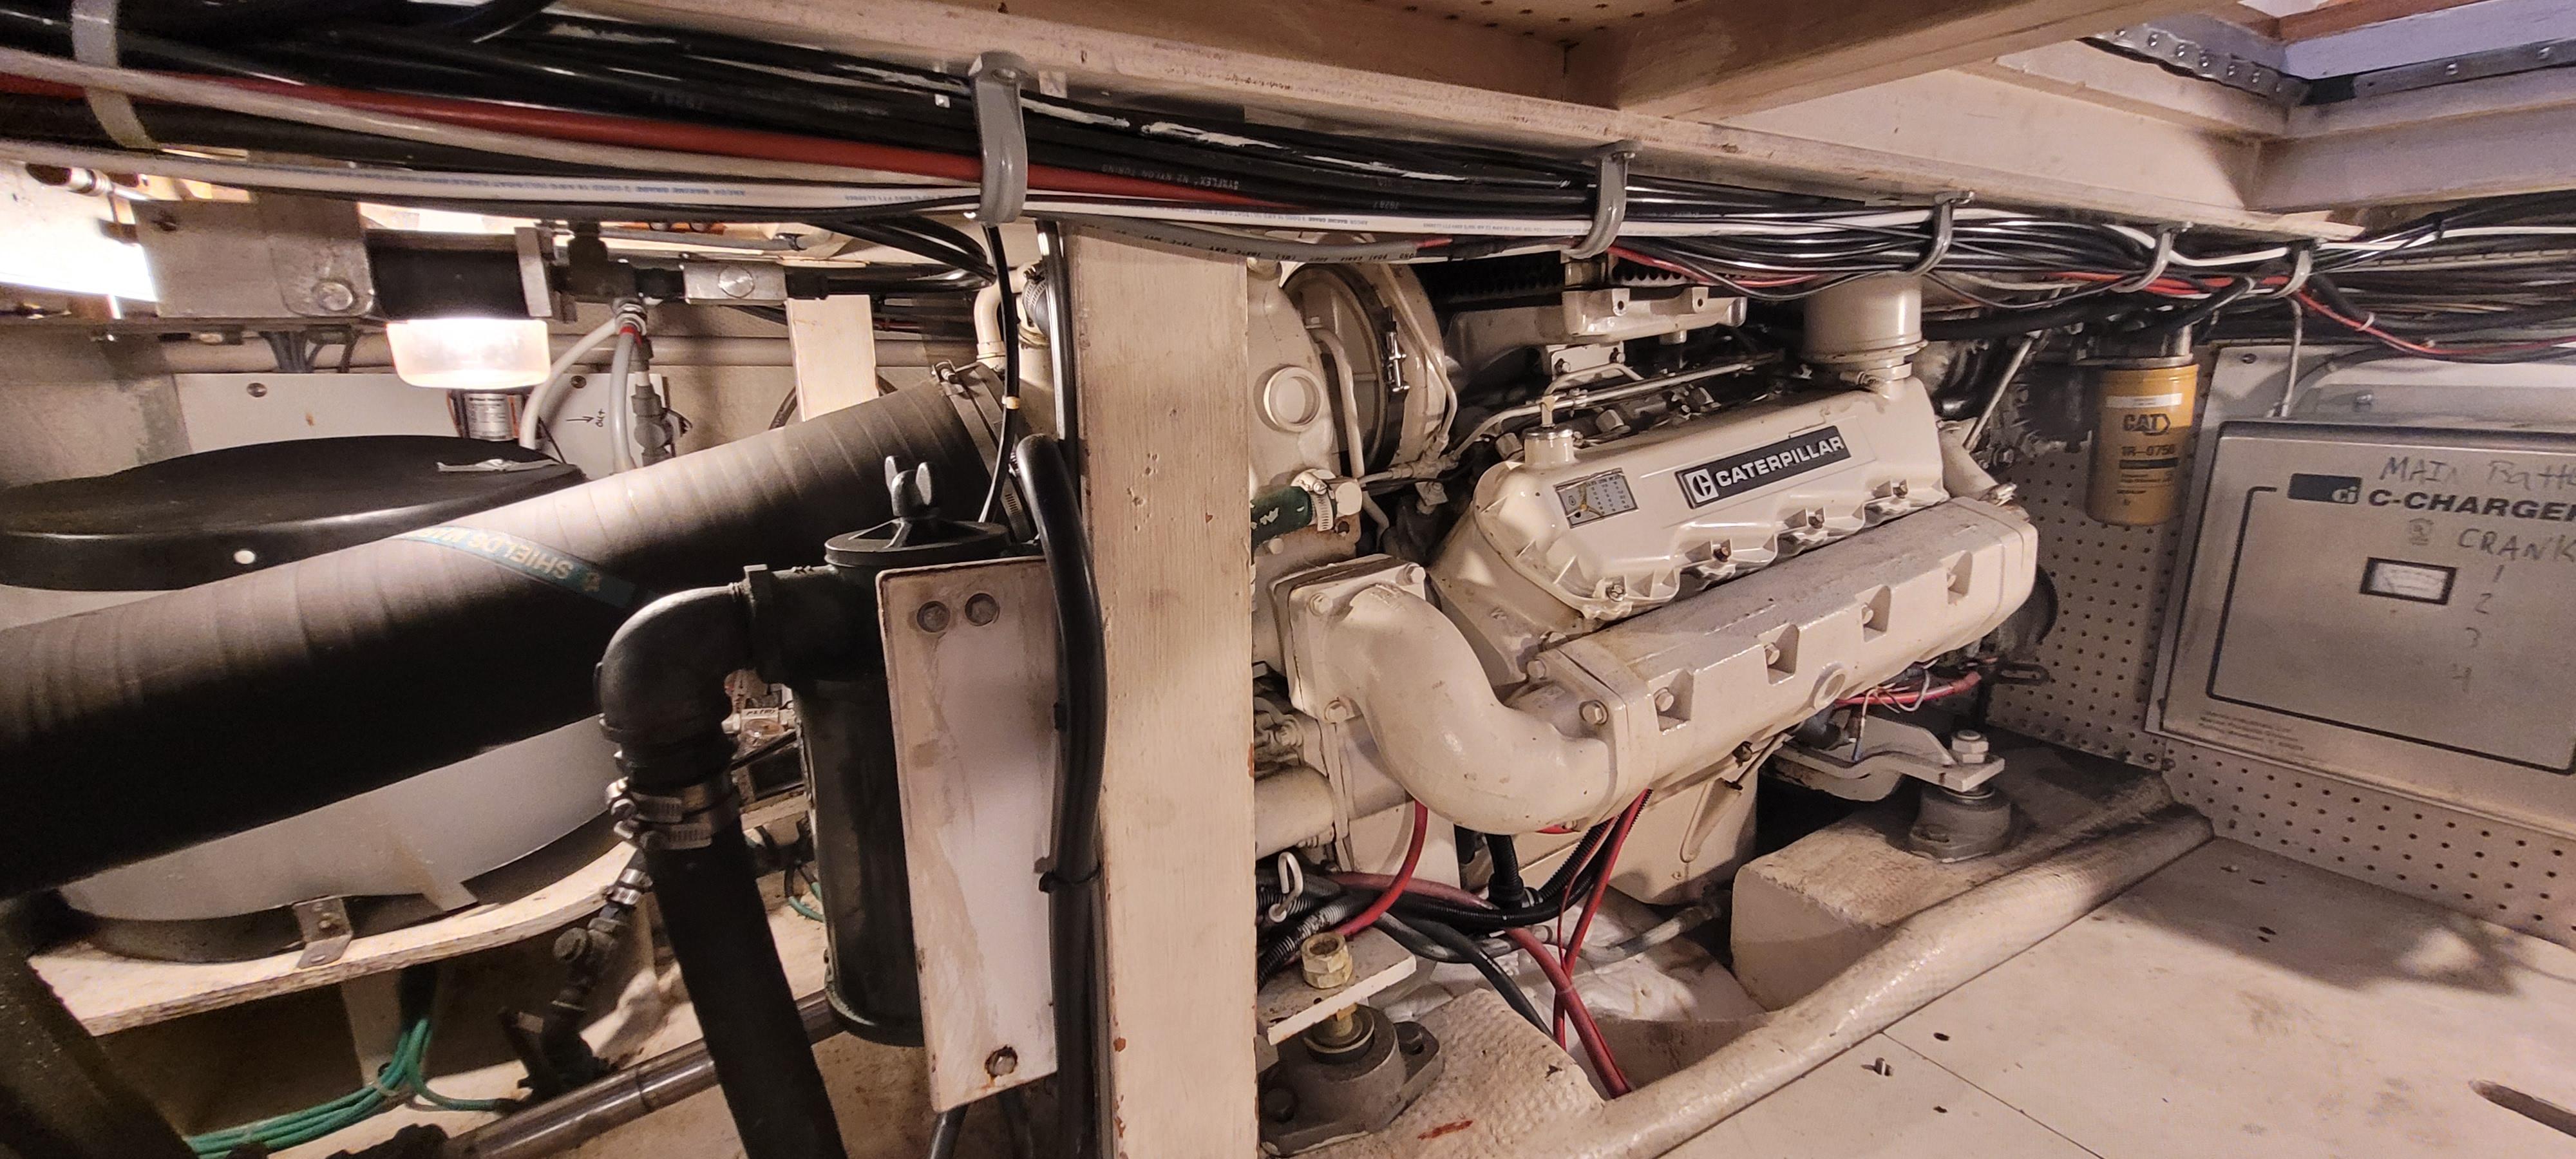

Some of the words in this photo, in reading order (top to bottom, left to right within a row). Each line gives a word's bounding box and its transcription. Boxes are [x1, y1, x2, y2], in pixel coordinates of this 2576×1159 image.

[2123, 414, 2162, 432] CAT
[1716, 436, 1845, 487] CATERPILLAR
[468, 534, 574, 579] SHIELDS
[2475, 592, 2492, 615] 2
